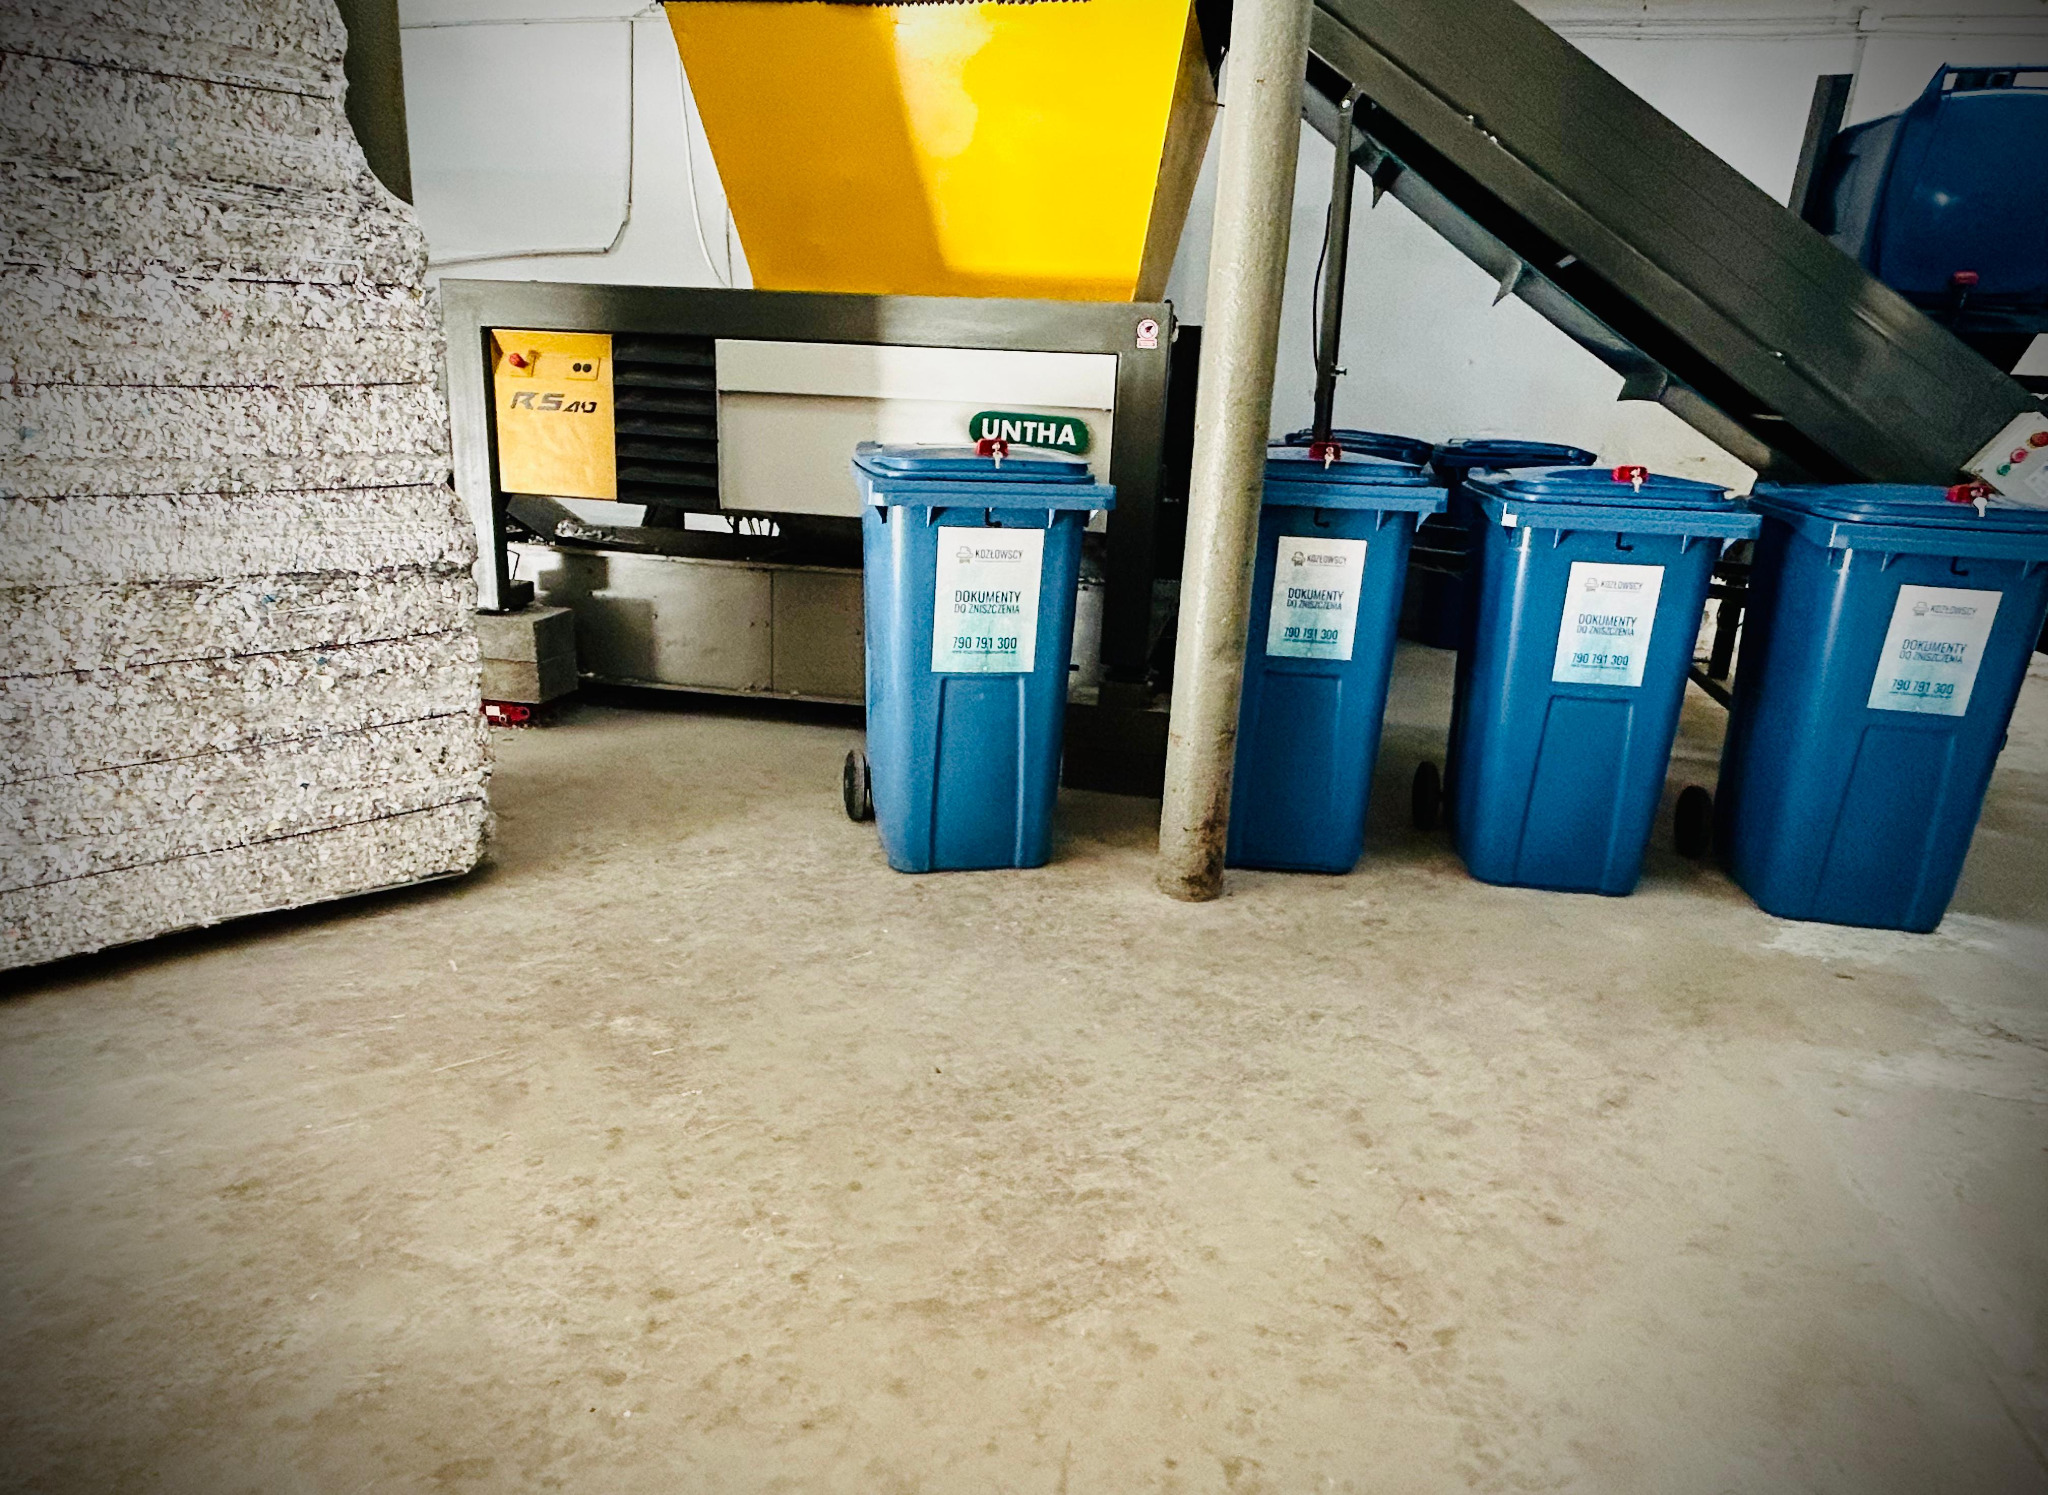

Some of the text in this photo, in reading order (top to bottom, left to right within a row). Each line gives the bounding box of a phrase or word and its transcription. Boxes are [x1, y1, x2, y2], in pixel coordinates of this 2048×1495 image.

[981, 418, 1077, 446] UNTHA
[975, 549, 1023, 559] KOZŁOWSCY
[955, 590, 1021, 603] DOKUMENTY
[1288, 588, 1344, 601] DOKUMENTY
[954, 603, 1020, 614] DO ZNISZCZENIA
[1287, 599, 1297, 607] DO
[1578, 613, 1638, 626] DOKUMENTY
[1284, 627, 1338, 640] 790 791 300
[1576, 625, 1587, 634] DO
[952, 636, 1017, 649] 790 791 300
[1902, 639, 1967, 653] DOKUMENTY
[1572, 652, 1629, 666] 790 791 300
[1898, 650, 1911, 660] DO
[1892, 678, 1954, 694] 790 791 300
